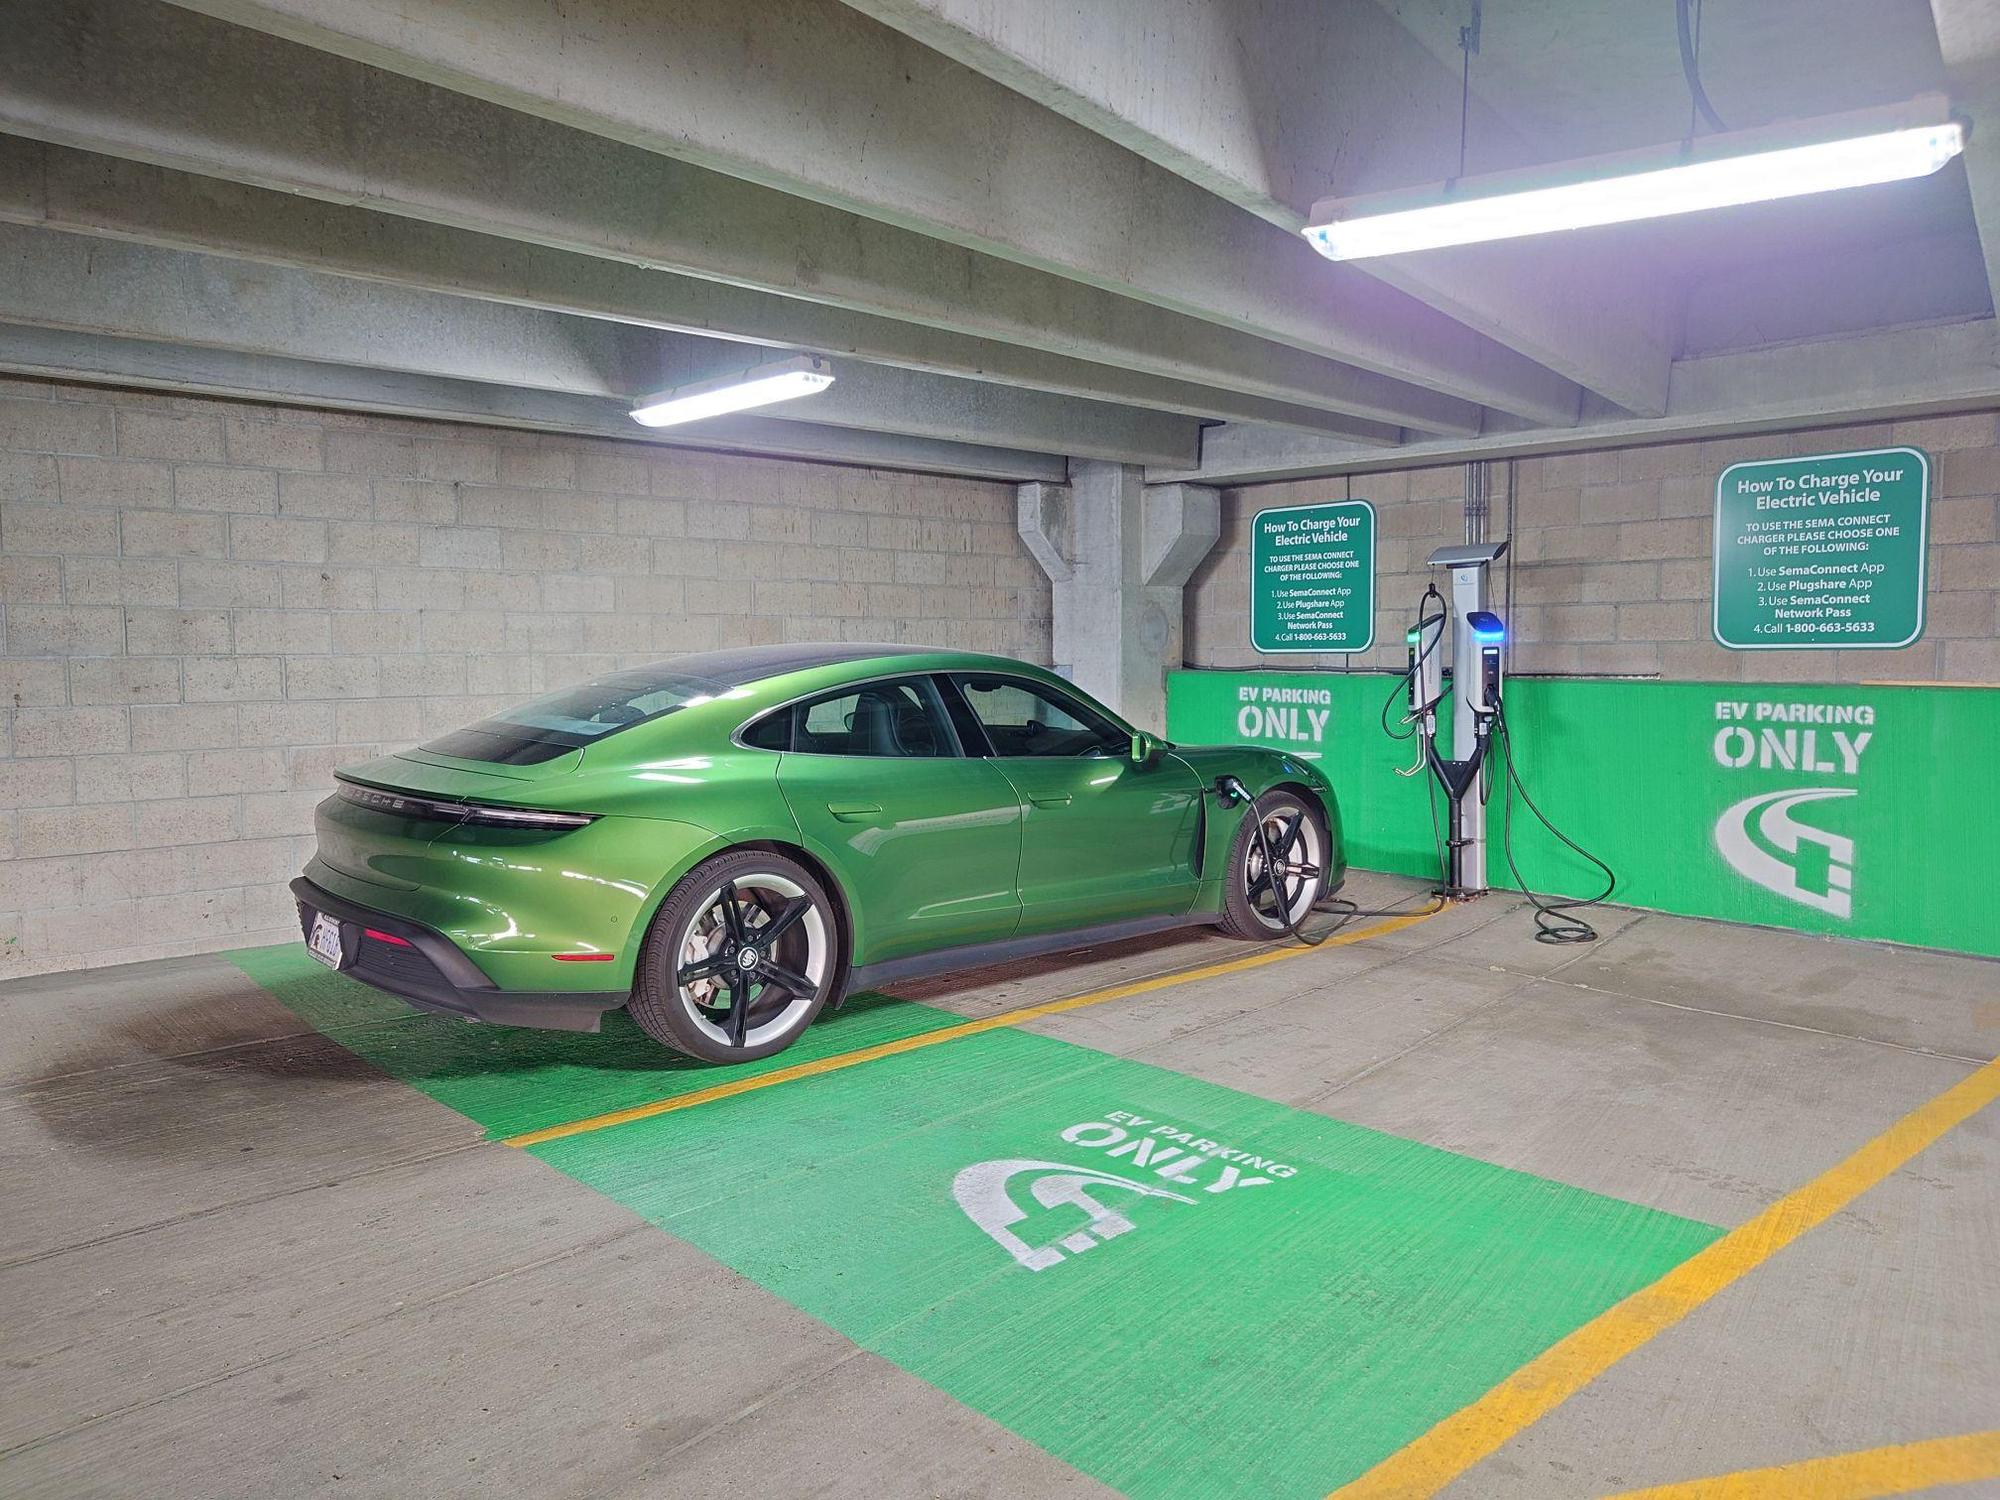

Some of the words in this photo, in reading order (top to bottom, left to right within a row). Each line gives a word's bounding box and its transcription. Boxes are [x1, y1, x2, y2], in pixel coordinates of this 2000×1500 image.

[1737, 480, 1774, 494] How
[1776, 477, 1796, 491] To
[1799, 473, 1860, 489] Charge
[1863, 469, 1904, 483] Your
[1756, 492, 1816, 510] Electric
[1818, 488, 1881, 505] Vehicle
[1264, 523, 1286, 533] How
[1287, 521, 1299, 531] To
[1300, 519, 1336, 531] Charge
[1337, 516, 1361, 527] Your
[1746, 523, 1760, 532] TO
[1762, 521, 1781, 531] USE
[1783, 520, 1803, 529] THE
[1805, 518, 1835, 528] SEMA
[1837, 514, 1891, 526] CONNECT
[1275, 534, 1311, 546] Electric
[1312, 531, 1348, 543] Vehicle
[1737, 534, 1786, 545] CHARGER
[1787, 531, 1826, 542] PLEASE
[1828, 528, 1873, 540] CHOOSE
[1875, 527, 1900, 537] ONE
[1305, 553, 1322, 561] SEMA
[1323, 551, 1354, 559] CONNECT
[1763, 547, 1777, 556] OF
[1780, 545, 1799, 555] THE
[1801, 542, 1869, 554] FOLLOWING:
[1264, 565, 1293, 573] CHARGER
[1294, 563, 1317, 571] PLEASE
[1758, 567, 1777, 577] Use
[1779, 564, 1858, 576] SemaConnect
[1860, 563, 1885, 575] App
[1303, 572, 1342, 580] FOLLOWING:
[1290, 588, 1337, 597] SemaConnect
[1337, 587, 1352, 596] App
[1768, 582, 1787, 591] Use
[1789, 579, 1847, 592] Plugshare
[1848, 578, 1873, 590] App
[1296, 600, 1329, 610] Plugshare
[1330, 600, 1345, 608] App
[1769, 596, 1788, 606] Use
[1790, 594, 1871, 605] SemaConnect
[1297, 611, 1344, 619] SemaConnect
[1775, 608, 1823, 619] Network
[1826, 608, 1852, 618] Pass
[1288, 622, 1317, 630] Network
[1764, 624, 1783, 633] Call
[1786, 622, 1875, 633] 1-800-663-5633
[1294, 633, 1347, 641] 1-800-663-5633
[1239, 687, 1259, 701] EV
[1262, 688, 1331, 705] PARKING
[1715, 702, 1750, 720] EV
[1756, 702, 1874, 725] PARKING
[1238, 706, 1330, 742] ONLY
[1714, 726, 1873, 774] ONLY
[1104, 1110, 1154, 1126] EV
[1150, 1125, 1299, 1179] PARKING
[1060, 1122, 1275, 1194] ONLY
